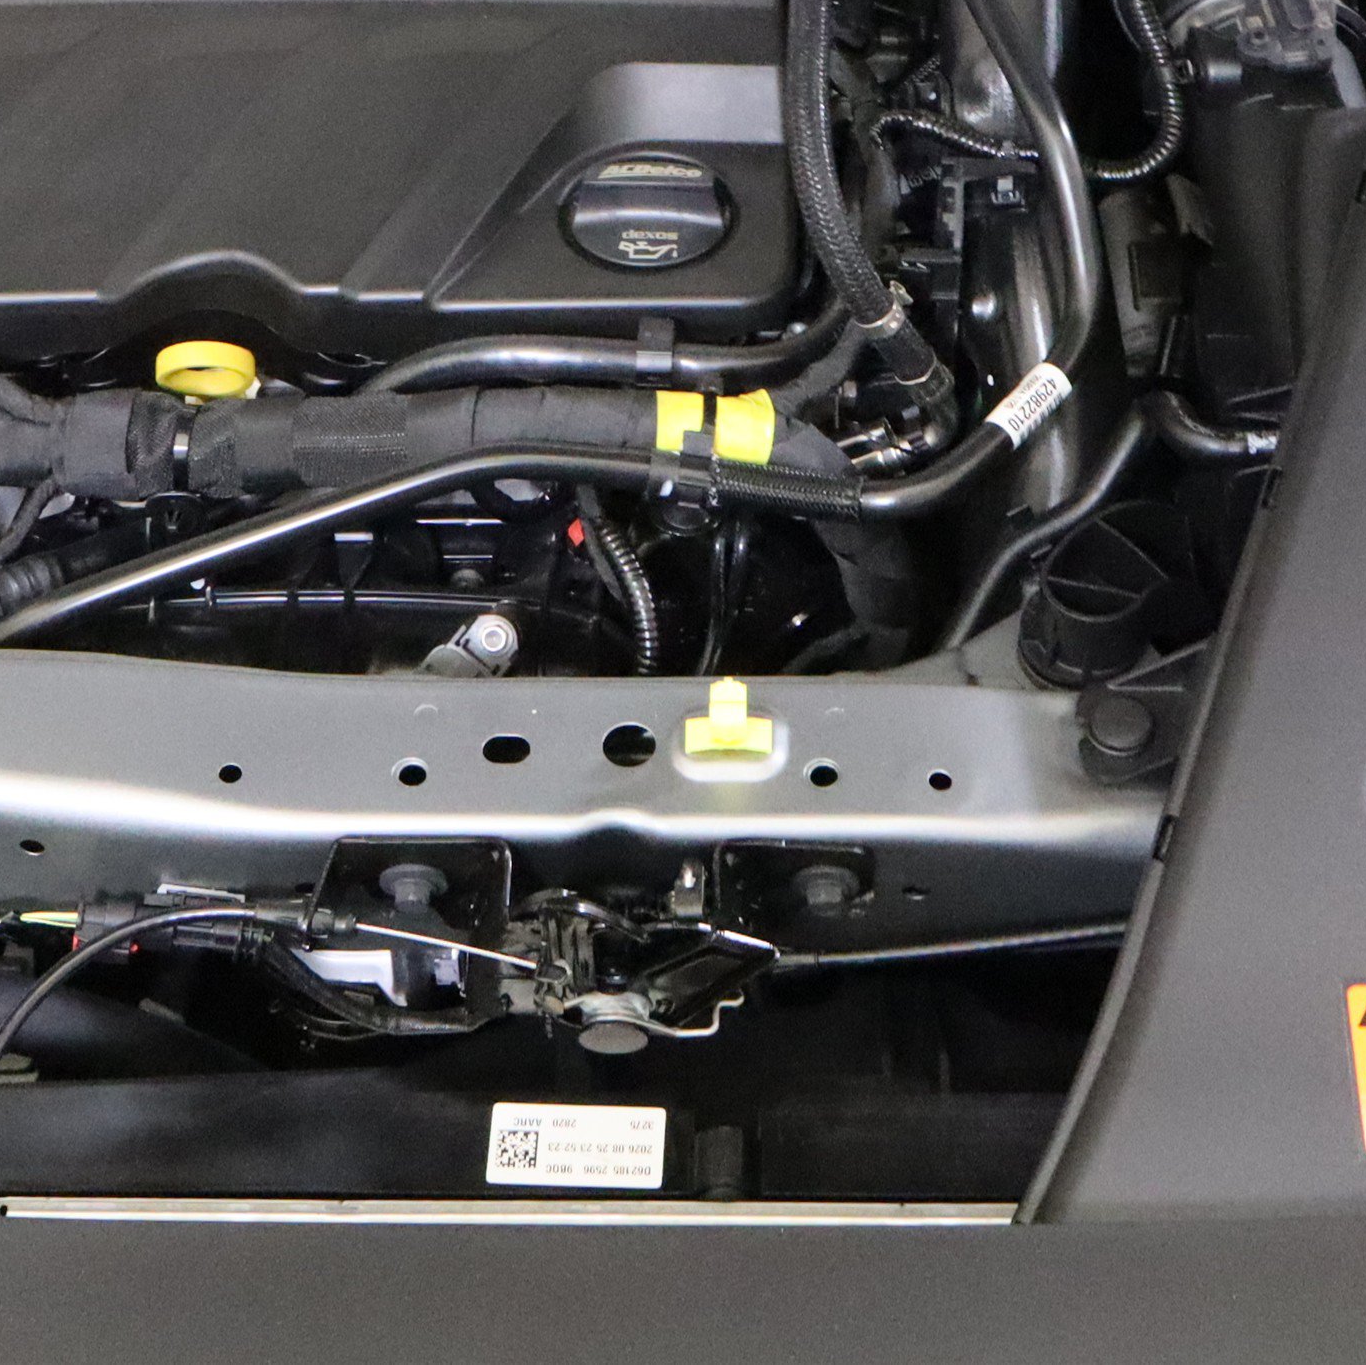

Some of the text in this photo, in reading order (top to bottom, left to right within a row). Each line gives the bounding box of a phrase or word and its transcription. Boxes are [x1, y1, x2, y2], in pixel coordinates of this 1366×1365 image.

[598, 164, 702, 179] ACDelco
[622, 229, 679, 240] dexos
[1008, 378, 1058, 432] 42982210
